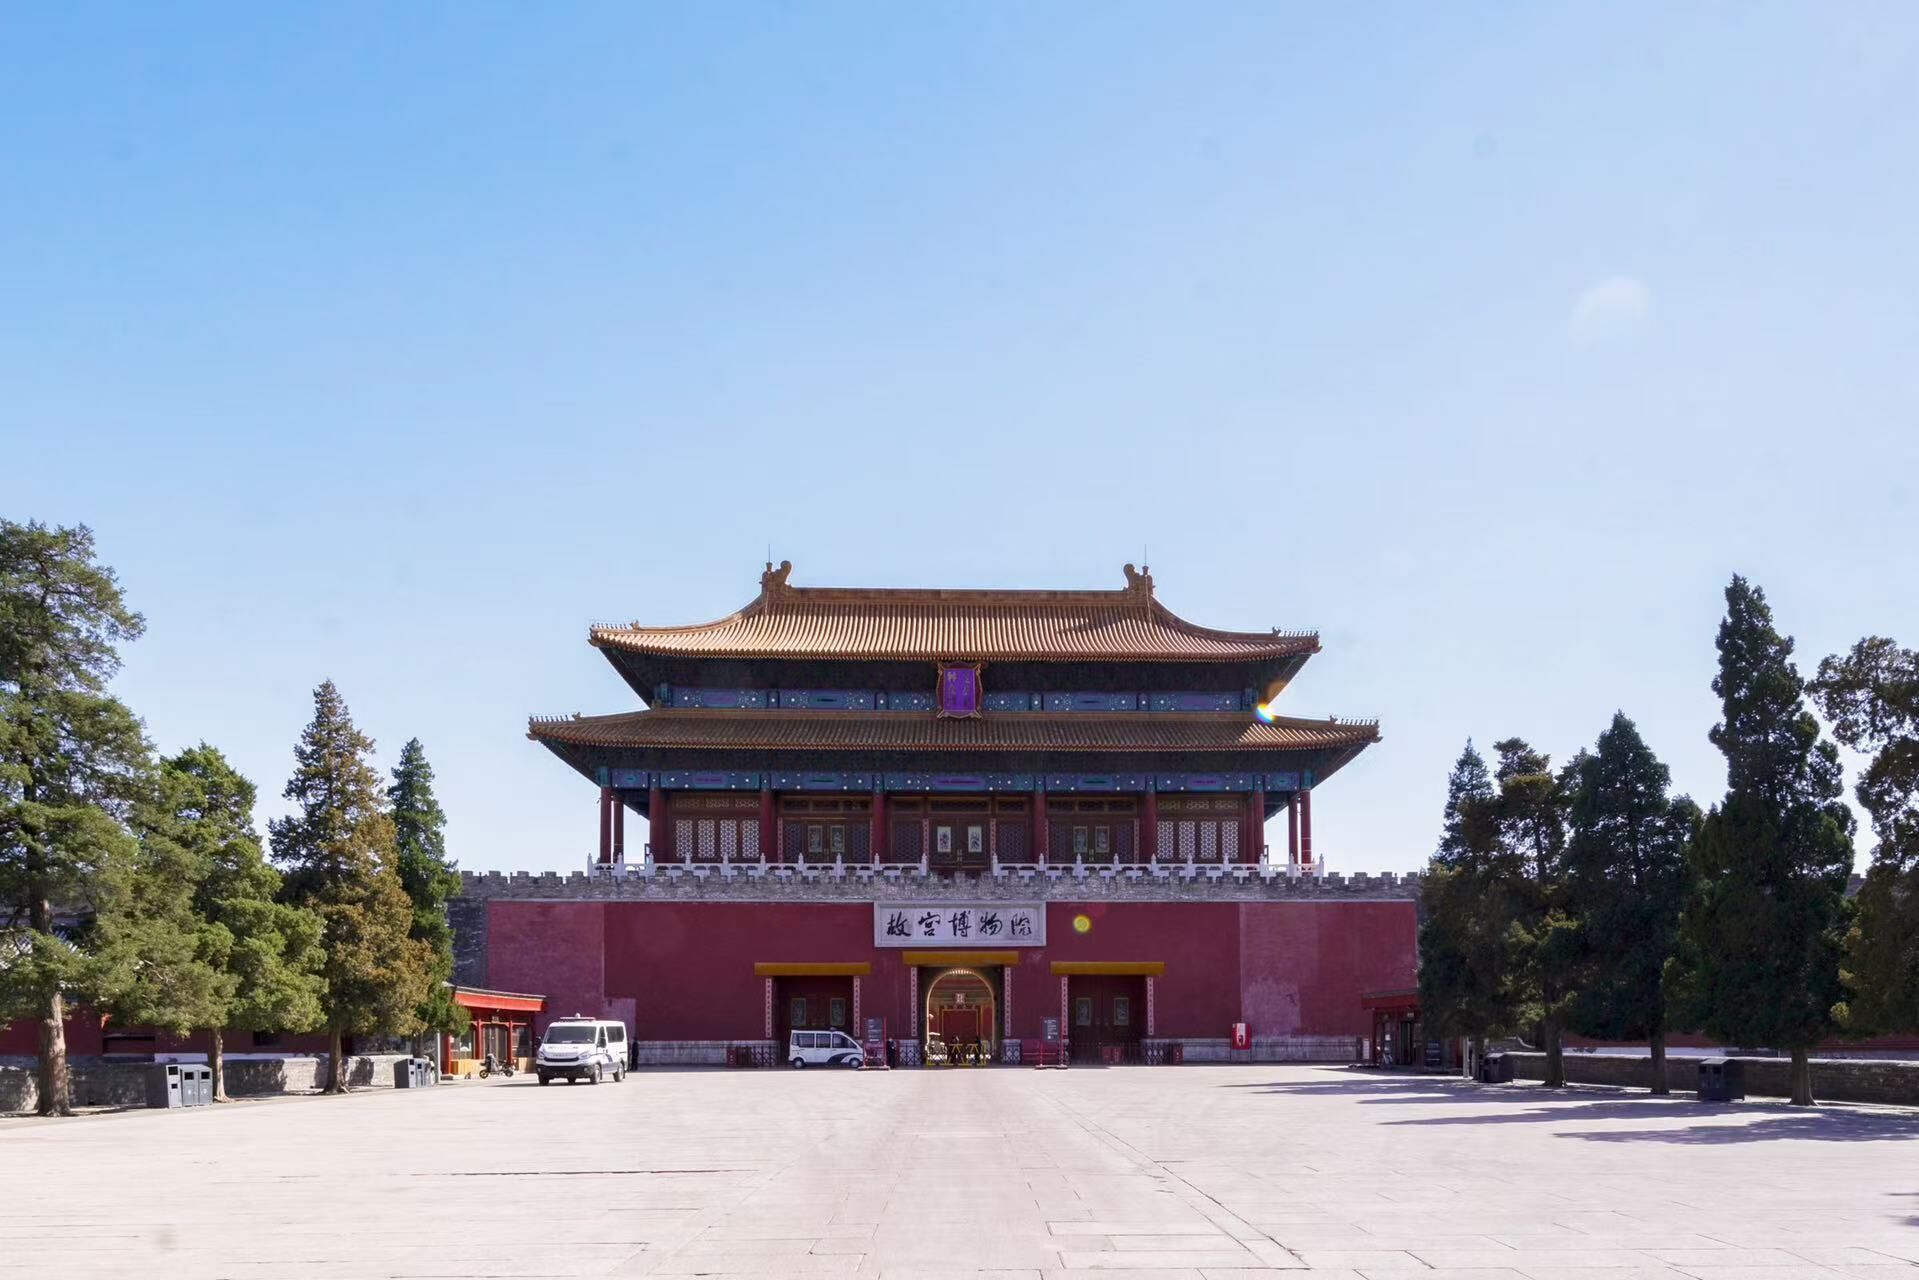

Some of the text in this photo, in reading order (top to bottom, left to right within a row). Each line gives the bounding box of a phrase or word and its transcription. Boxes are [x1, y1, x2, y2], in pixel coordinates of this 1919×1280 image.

[886, 910, 1032, 938] 故宫博物院
